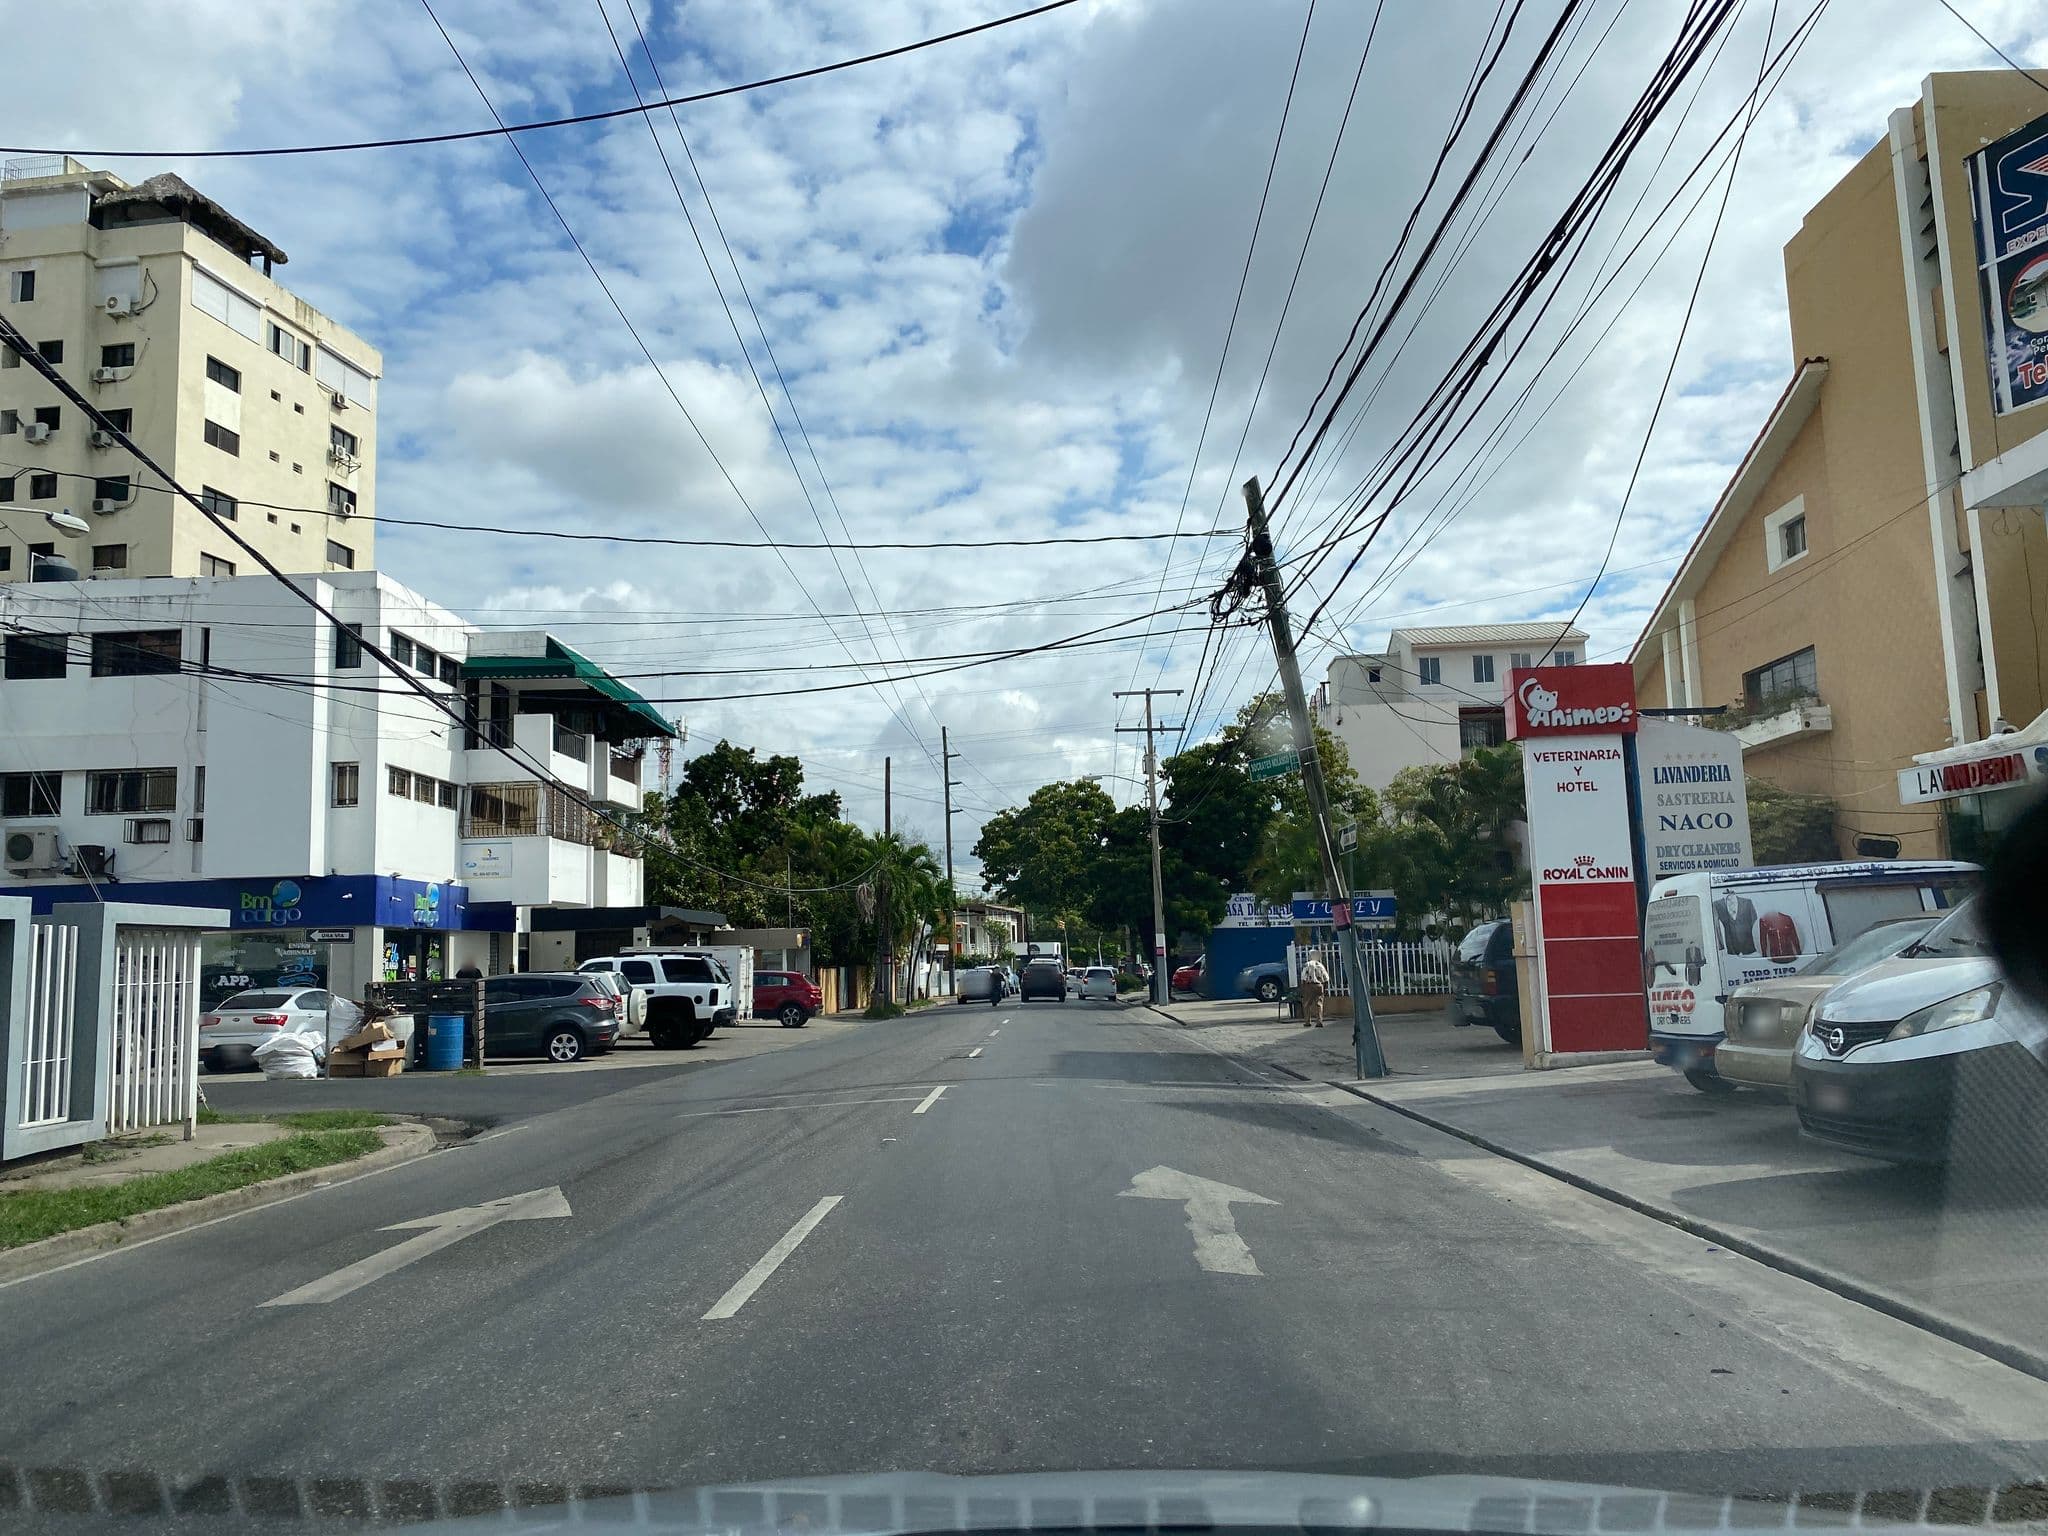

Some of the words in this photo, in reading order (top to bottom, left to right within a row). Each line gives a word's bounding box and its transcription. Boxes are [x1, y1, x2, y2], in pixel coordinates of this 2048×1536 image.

[1533, 749, 1621, 762] VETERINARIA
[1574, 766, 1582, 776] Y
[1653, 764, 1732, 784] LAVANDERIA
[1557, 781, 1598, 792] HOTEL
[1657, 791, 1735, 807] SASTRERIA
[1658, 812, 1733, 831] NACO
[1656, 844, 1681, 858] DRY
[1681, 841, 1741, 857] CLEANERS
[1660, 860, 1696, 870] SERVICIOS
[1704, 858, 1739, 869] DOMICILIO
[1543, 868, 1584, 880] ROYAL
[1586, 866, 1629, 879] CANIN
[1307, 900, 1381, 916] TUEY
[1742, 969, 1771, 978] TODO
[1773, 966, 1797, 975] TIPO
[217, 975, 250, 987] APP
[1728, 979, 1741, 987] DE
